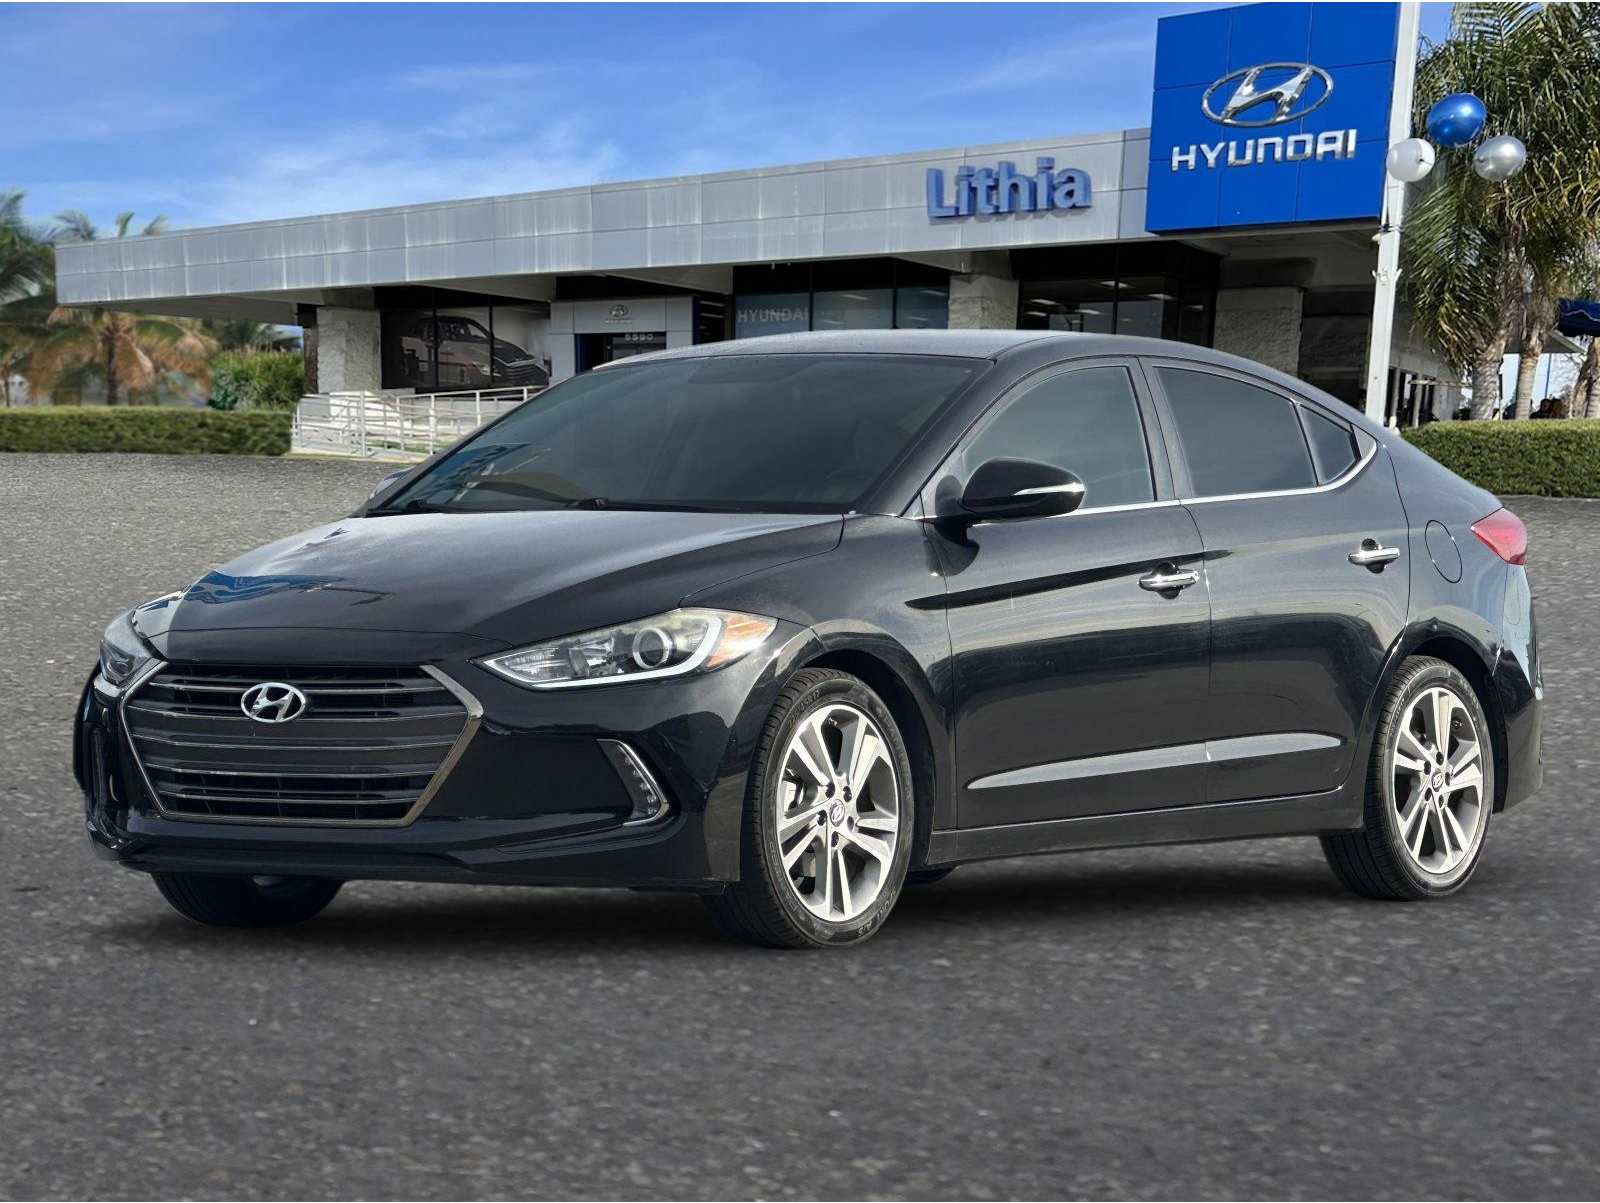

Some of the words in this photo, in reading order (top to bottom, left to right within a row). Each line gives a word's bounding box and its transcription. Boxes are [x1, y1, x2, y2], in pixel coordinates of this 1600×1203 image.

[1171, 129, 1357, 171] HYUNDAI
[926, 155, 1090, 218] Lithia
[736, 308, 808, 325] HYUNDAI
